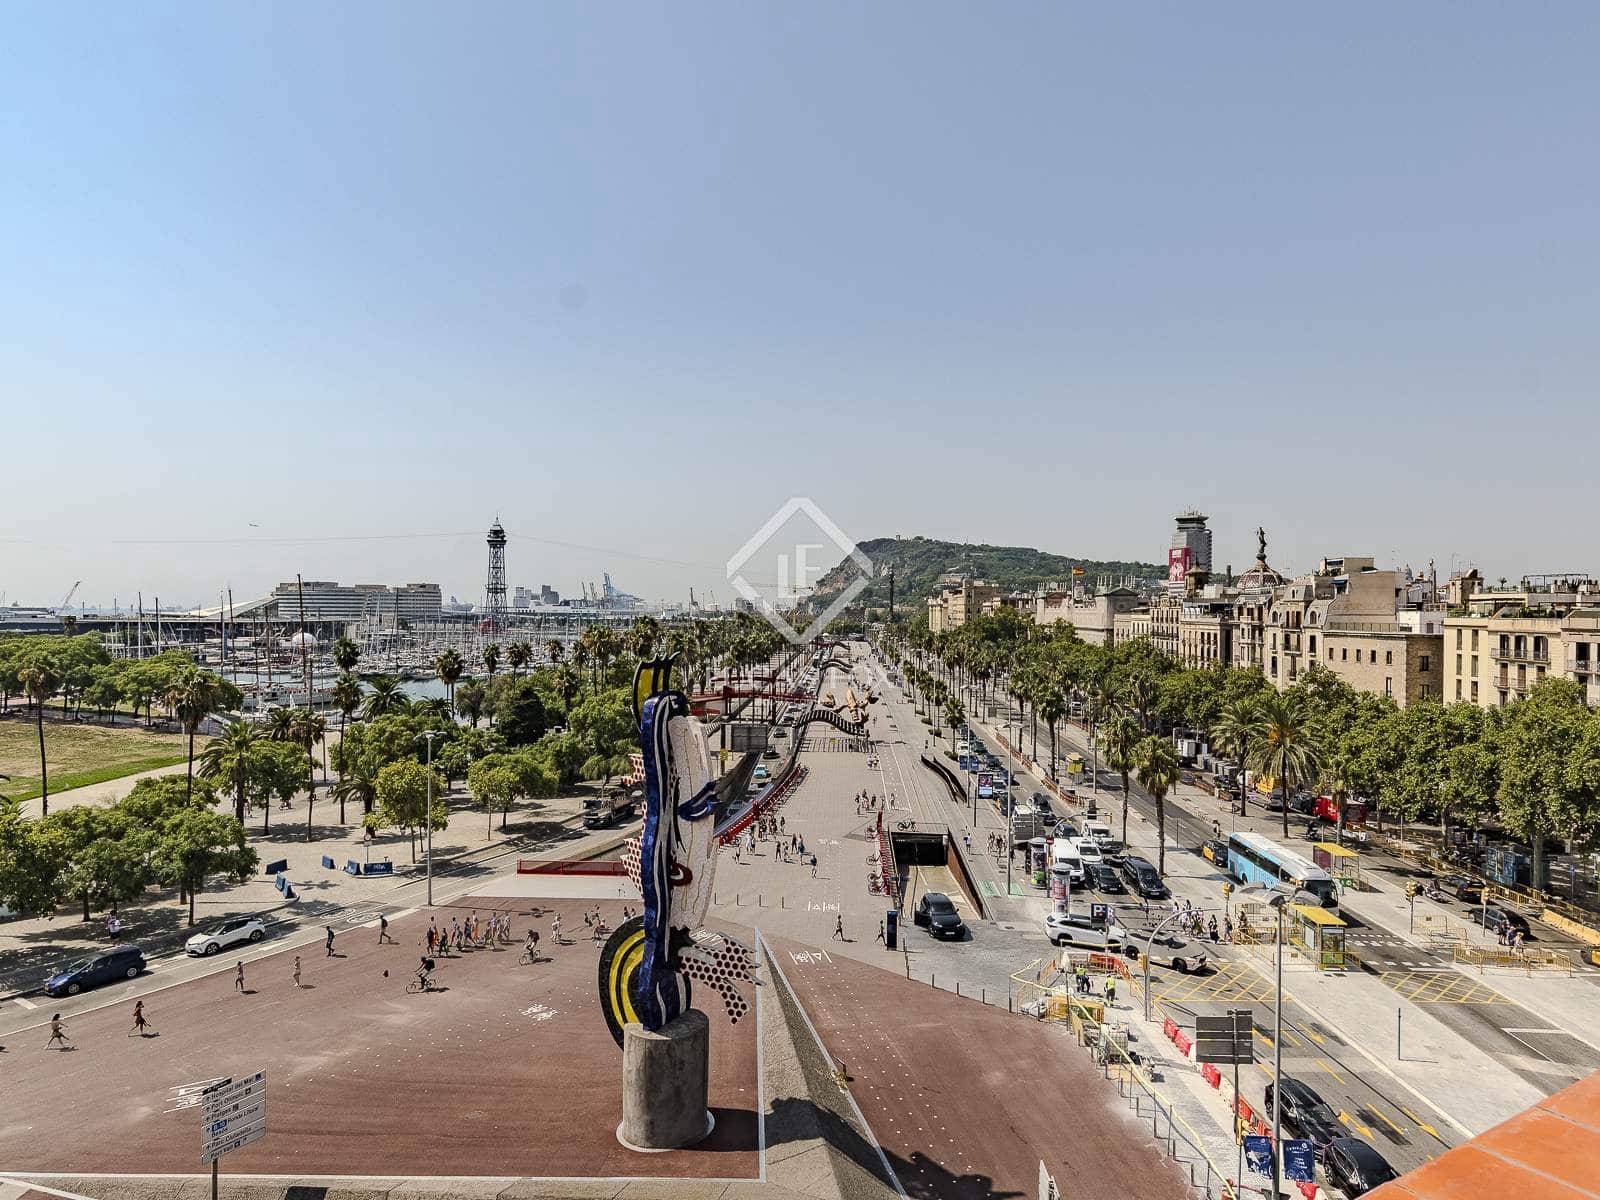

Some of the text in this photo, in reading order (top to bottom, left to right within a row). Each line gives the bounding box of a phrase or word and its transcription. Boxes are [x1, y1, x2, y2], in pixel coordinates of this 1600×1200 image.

[211, 1085, 234, 1099] Hospital
[244, 1077, 254, 1085] Mar
[211, 1101, 223, 1110] Port
[211, 1107, 232, 1119] Platges
[212, 1139, 224, 1147] Parc
[210, 1150, 223, 1159] Port
